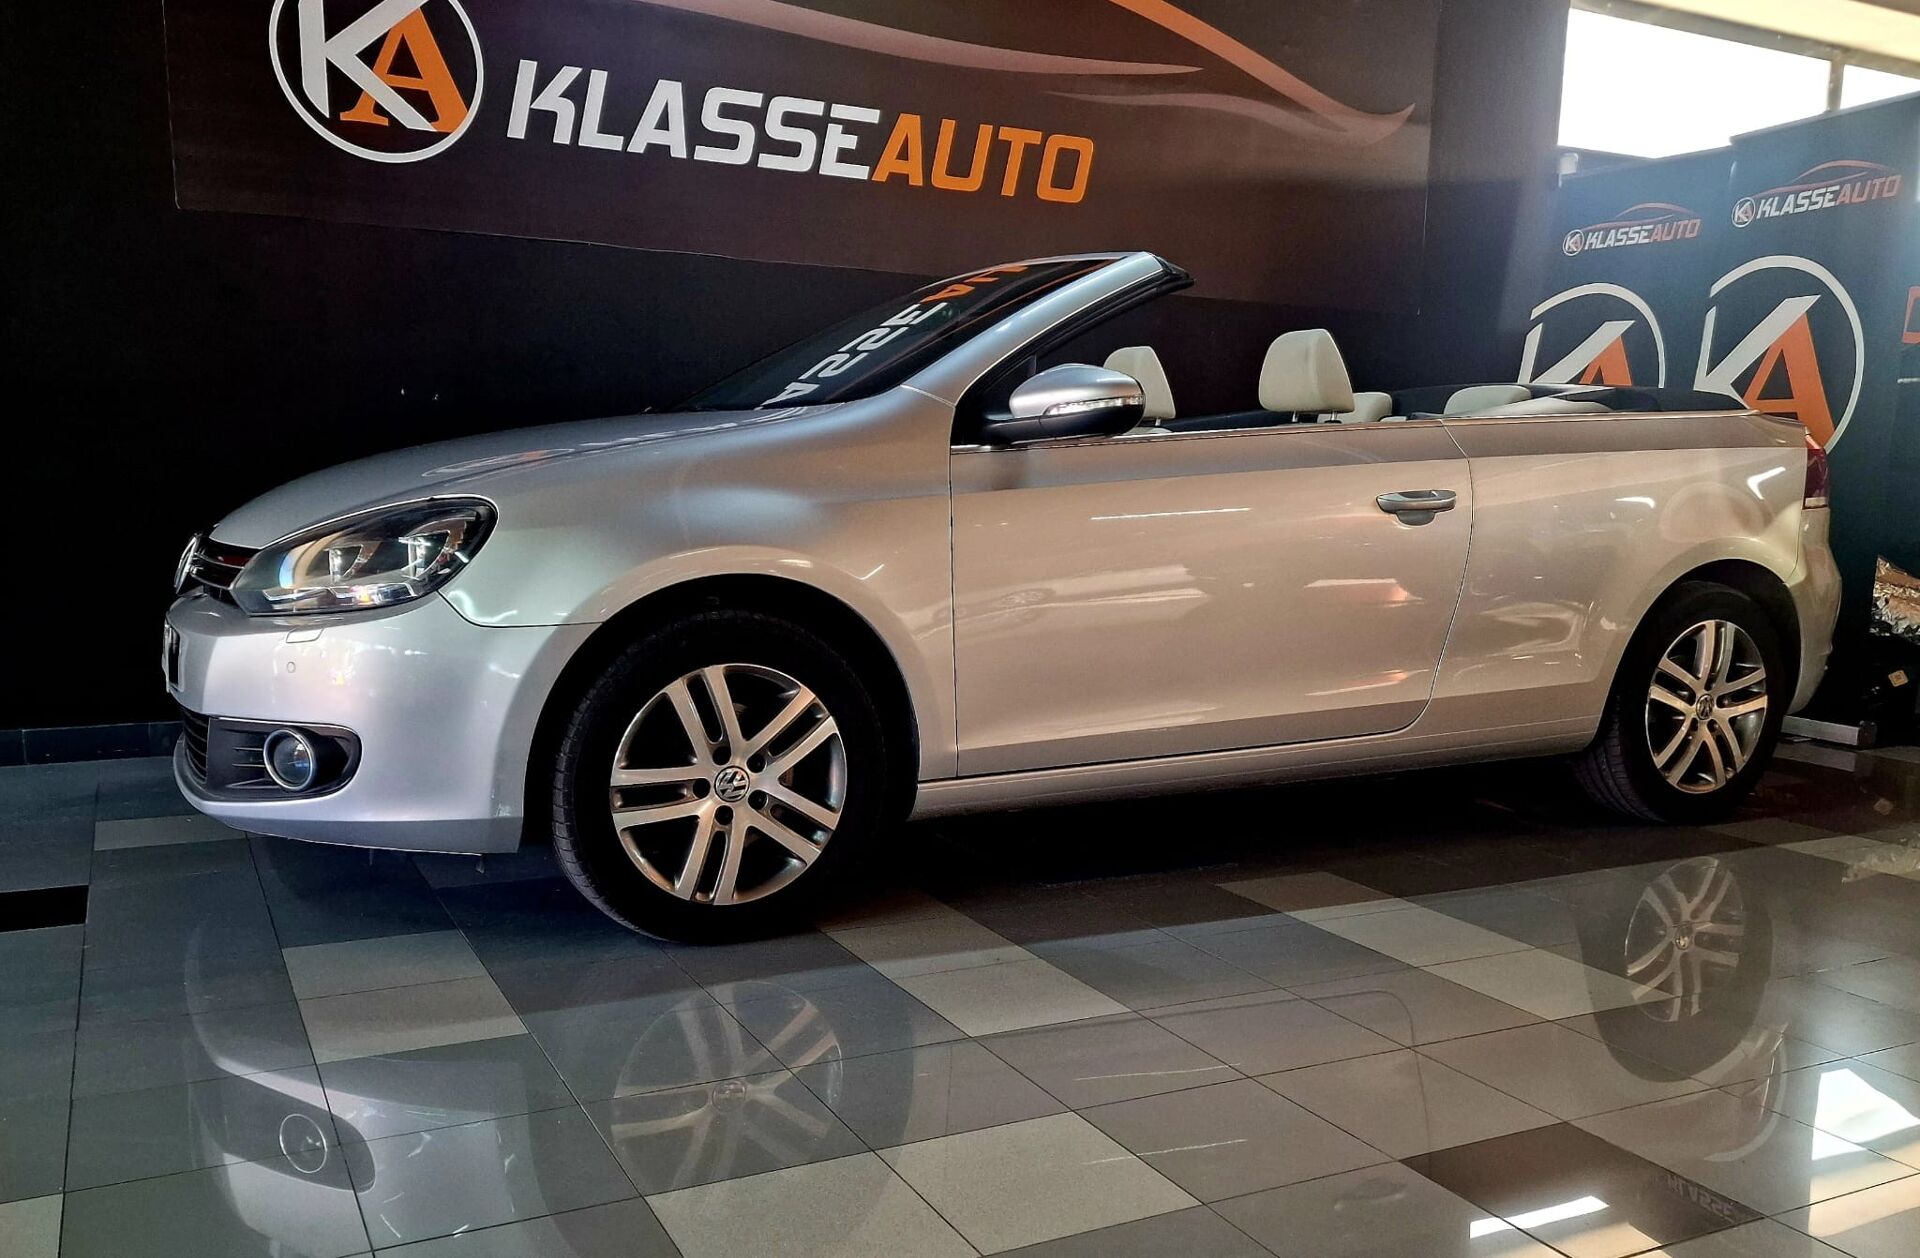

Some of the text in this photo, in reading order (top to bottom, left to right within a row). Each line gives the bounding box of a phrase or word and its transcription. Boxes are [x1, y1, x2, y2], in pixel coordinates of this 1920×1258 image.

[507, 59, 1095, 204] KLASSEAUTO
[1756, 174, 1902, 220] KLASSEAUTO
[1584, 218, 1702, 250] KLASSEAUTO
